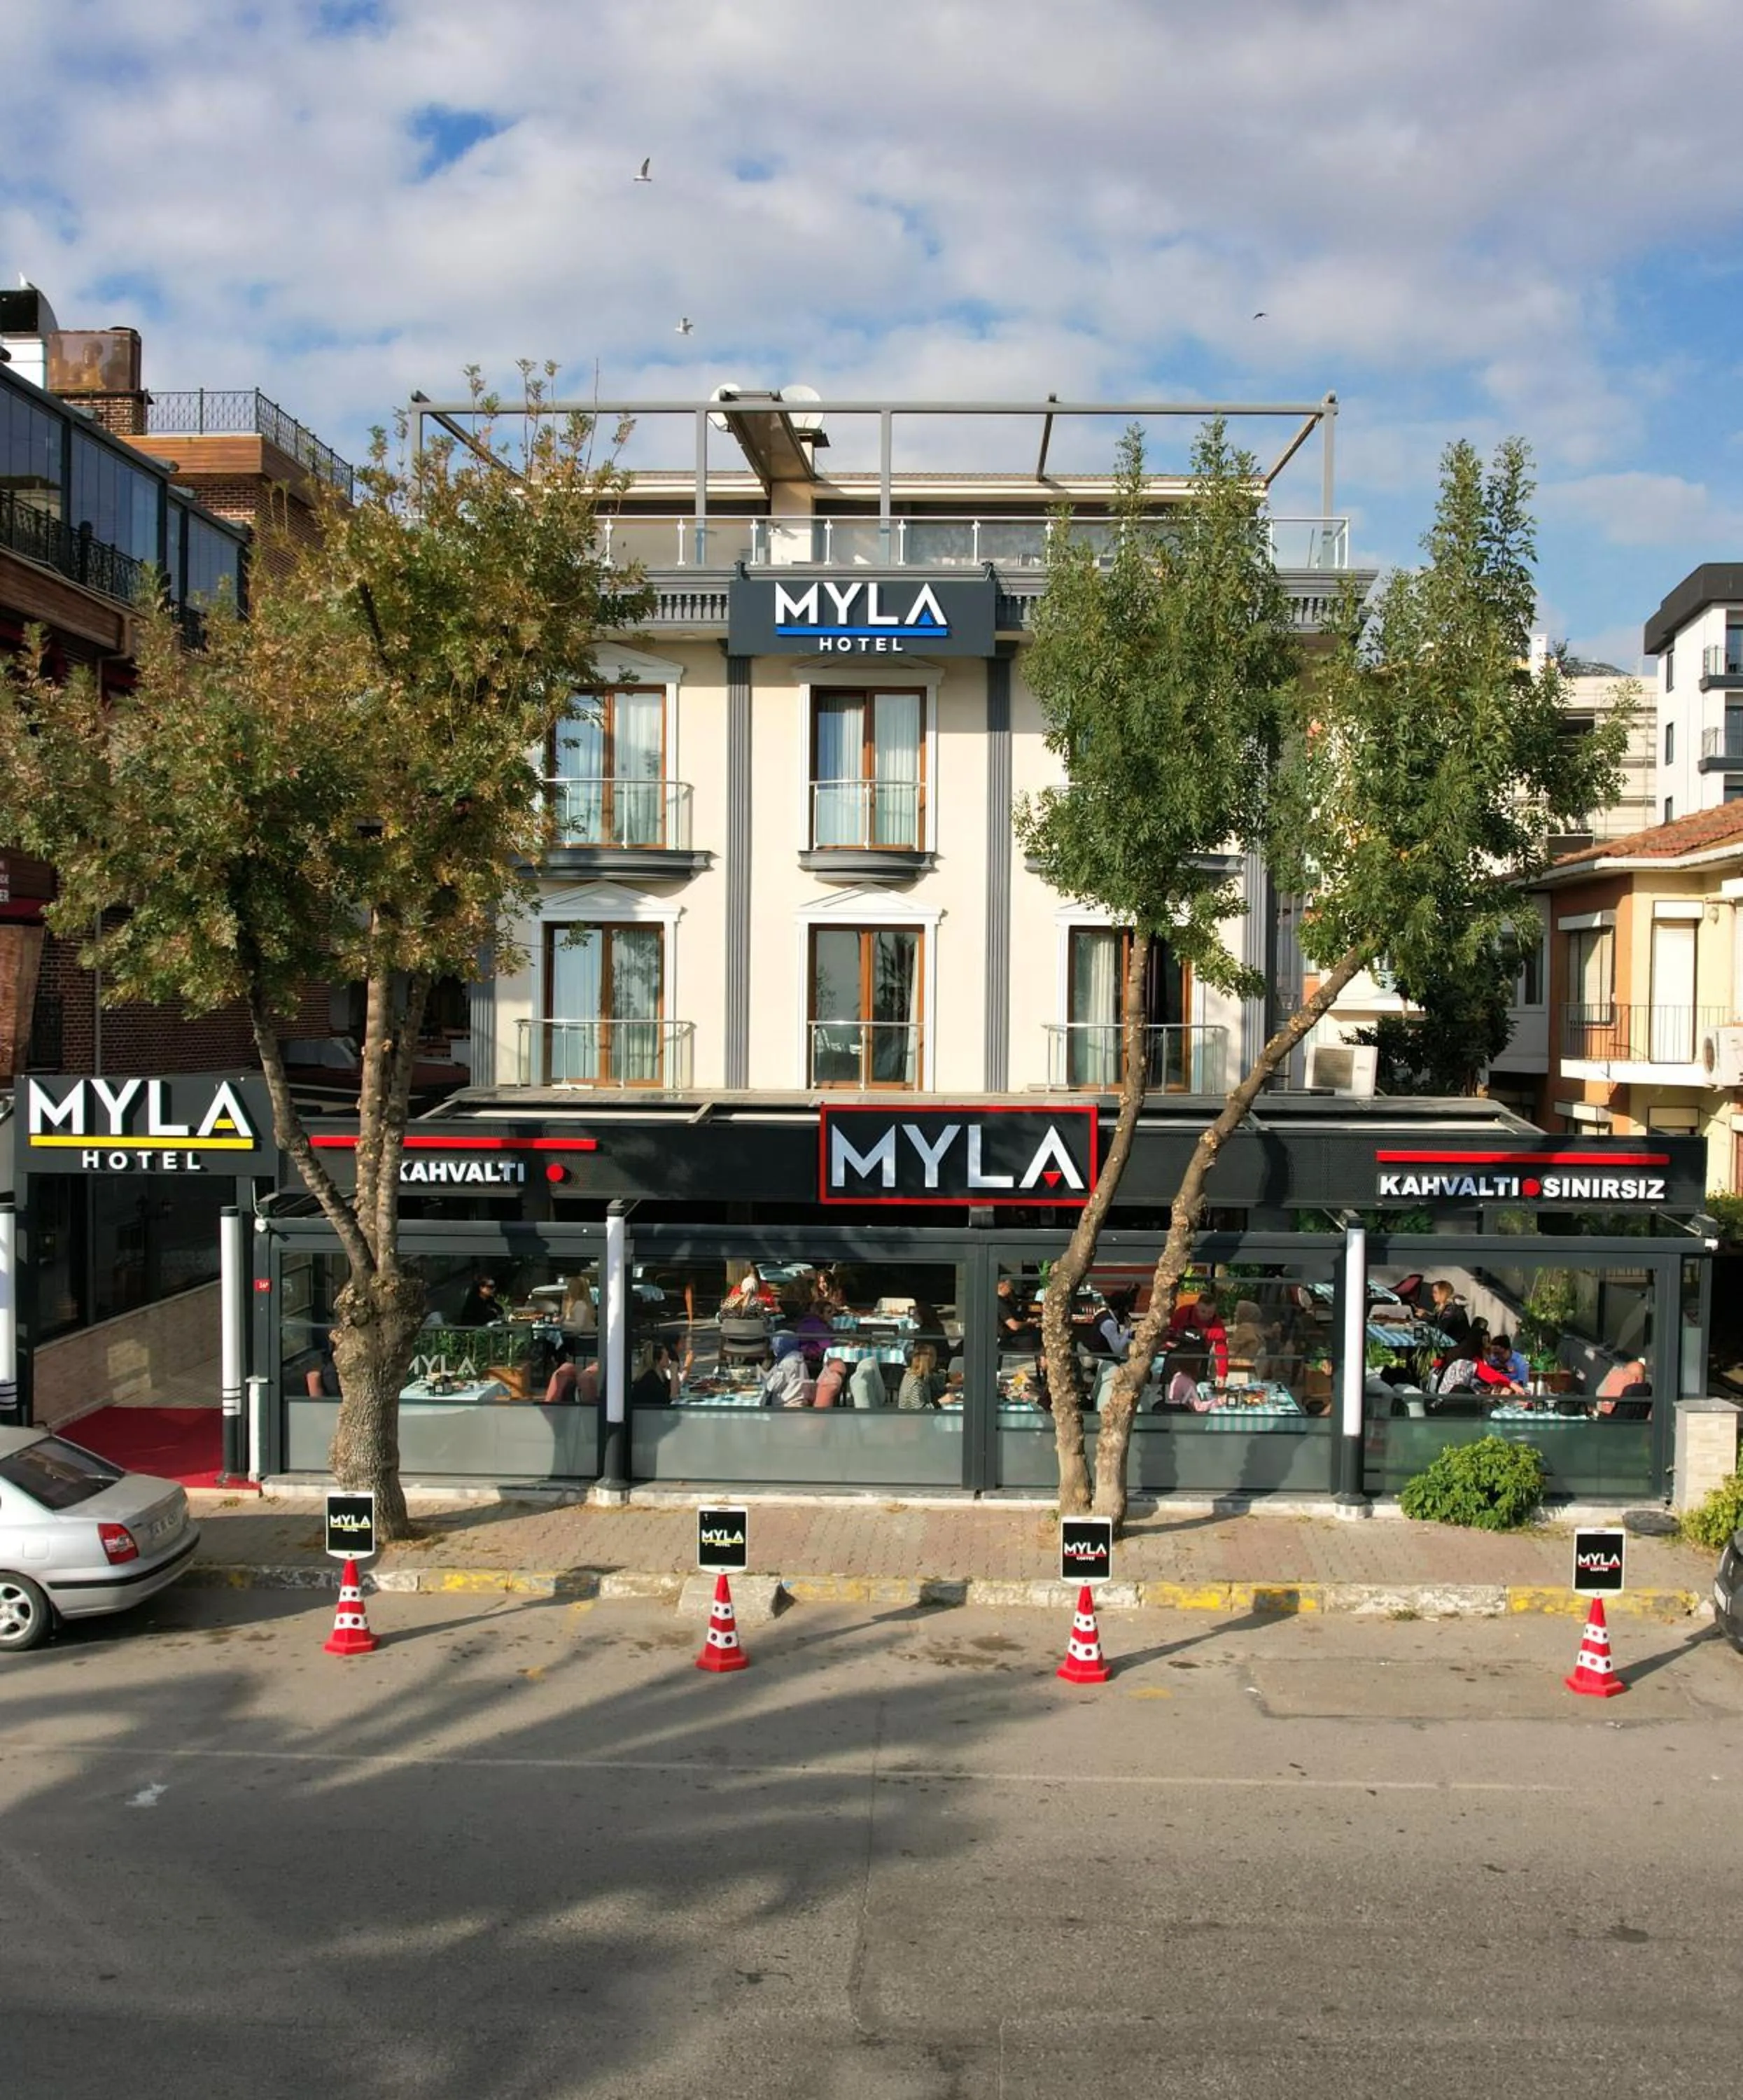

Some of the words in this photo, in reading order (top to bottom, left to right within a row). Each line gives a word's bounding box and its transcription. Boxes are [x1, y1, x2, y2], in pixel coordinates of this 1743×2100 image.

[775, 582, 947, 625] MYLA
[820, 638, 903, 652] HOTEL
[29, 1078, 253, 1137] MYLA
[83, 1150, 201, 1170] HOTEL
[832, 1124, 1085, 1189] MYLA
[1380, 1175, 1519, 1196] KAHVALTI
[1542, 1177, 1665, 1199] SINIRSIZ
[330, 1513, 371, 1527] MYLA
[701, 1529, 743, 1541] MYLA
[1064, 1542, 1107, 1555] MYLA
[1578, 1553, 1620, 1566] MYLA
